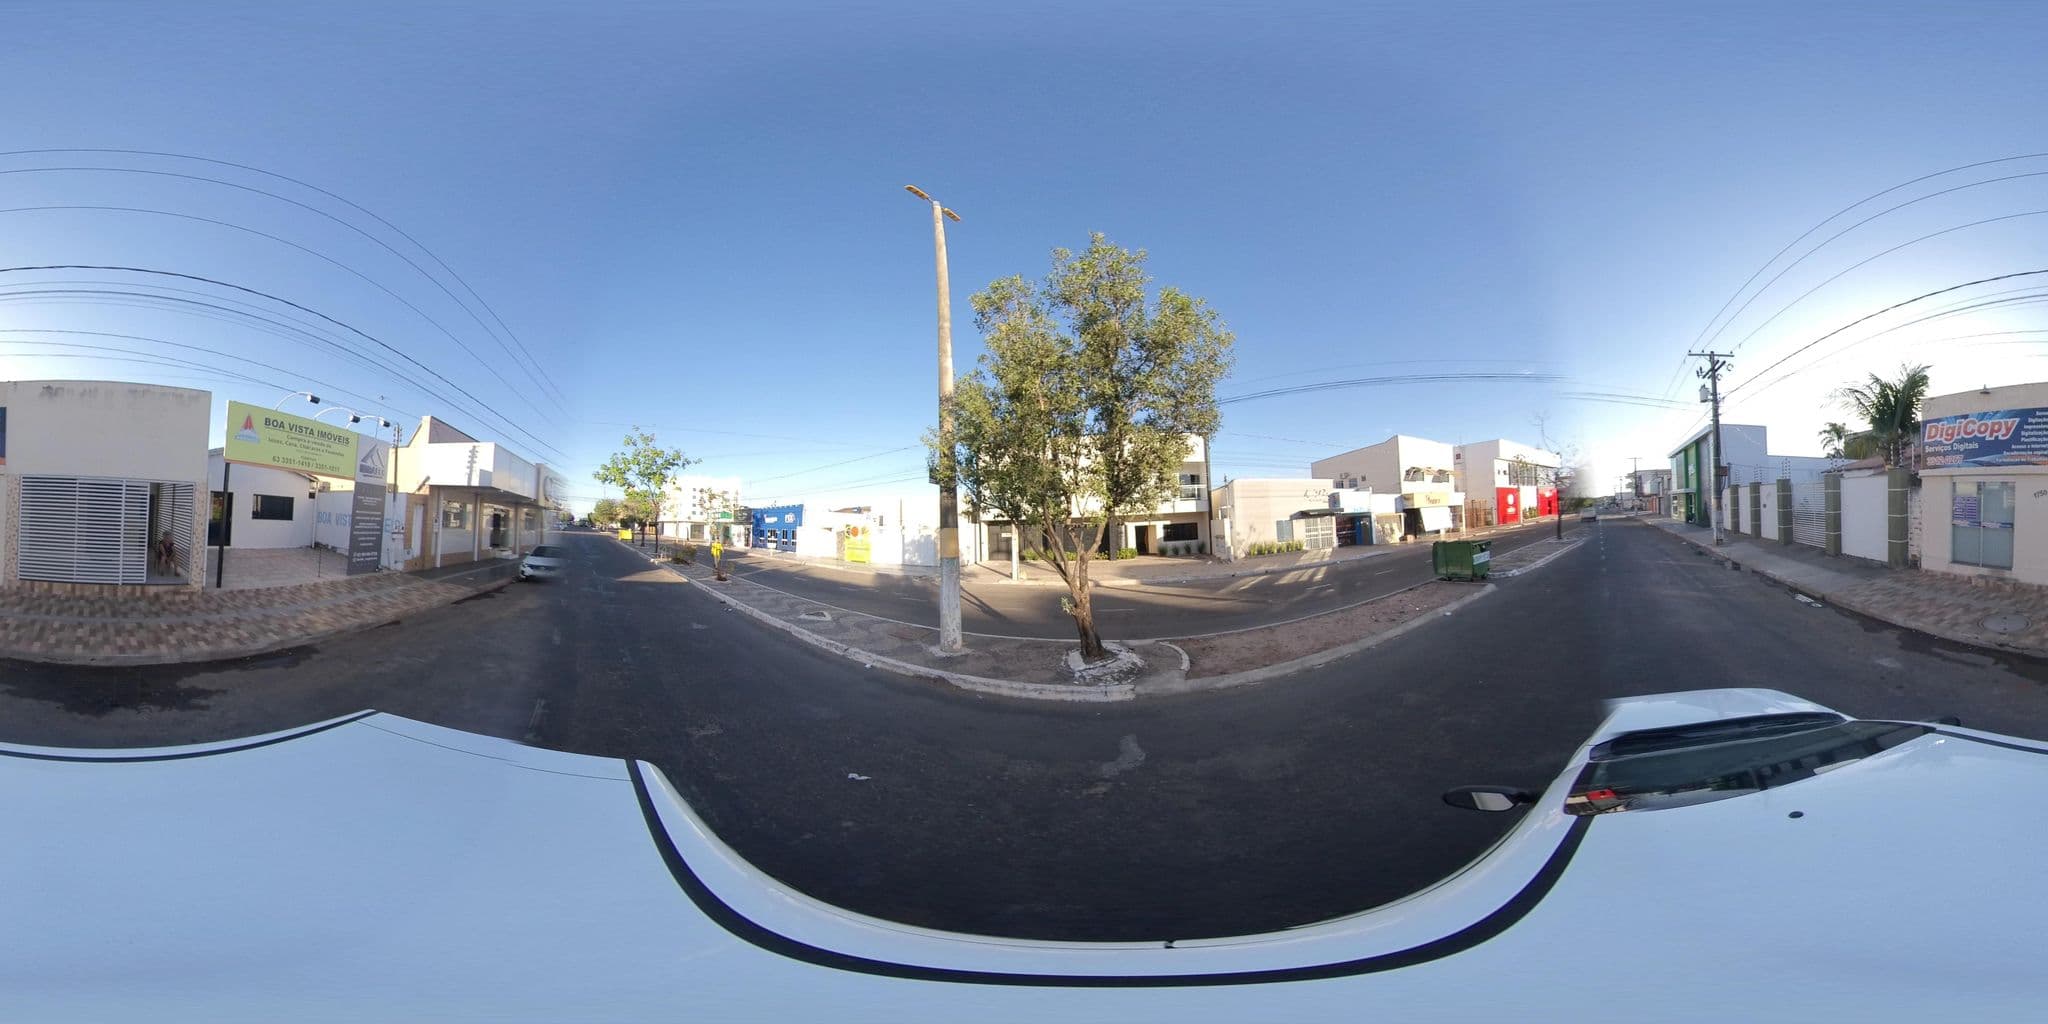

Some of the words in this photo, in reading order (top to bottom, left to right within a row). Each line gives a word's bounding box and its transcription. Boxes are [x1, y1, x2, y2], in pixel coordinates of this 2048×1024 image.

[264, 417, 285, 429] BOA
[288, 422, 315, 435] VISTA
[1924, 418, 2020, 443] DigiCopy
[1925, 444, 1952, 453] Serviços
[1952, 441, 1979, 451] Digitais
[335, 512, 352, 527] VIST
